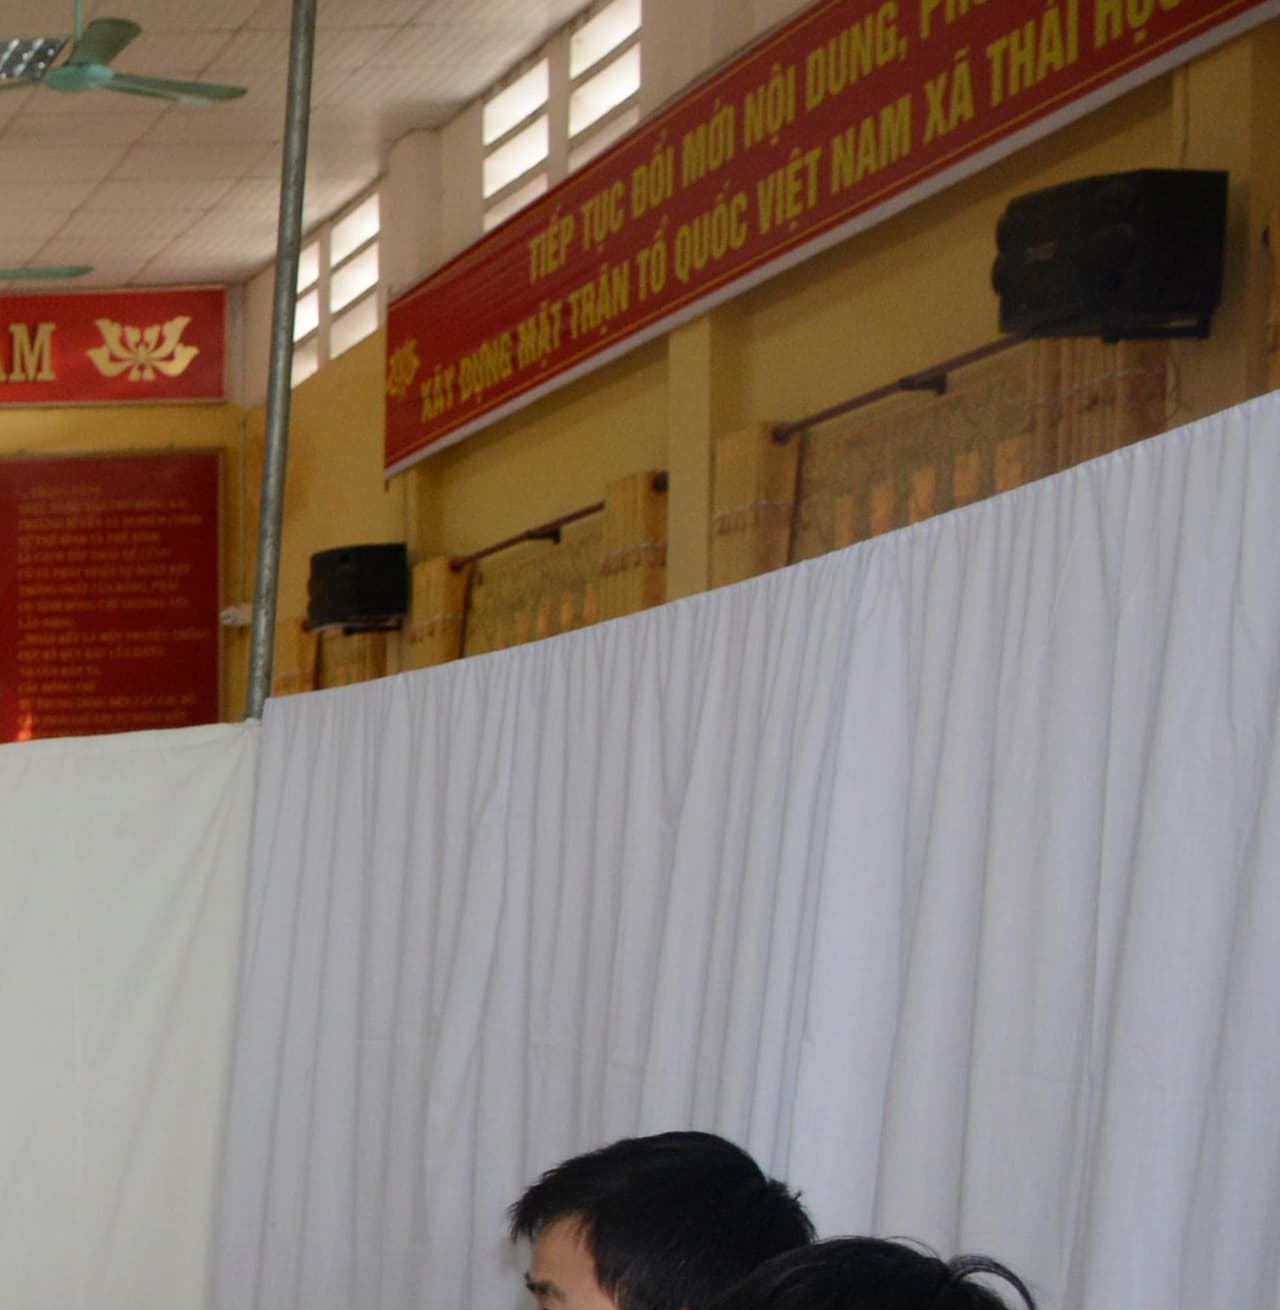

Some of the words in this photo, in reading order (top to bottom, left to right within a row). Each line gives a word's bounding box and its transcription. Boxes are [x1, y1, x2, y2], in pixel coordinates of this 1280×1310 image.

[421, 362, 455, 424] XÂY
[517, 300, 563, 369] MẶT
[568, 260, 630, 340] TRẬN
[637, 215, 668, 301] TỔ
[674, 178, 748, 283] QUỐC
[756, 146, 823, 235] VIỆT
[831, 93, 913, 196] NAM
[923, 45, 975, 144] XÃ
[528, 203, 575, 285] TIẾP
[582, 181, 624, 254] TỤC
[632, 127, 674, 220] ĐỔI
[682, 97, 735, 189] MỚI
[744, 63, 796, 149] NỘI
[805, 2, 908, 113] DUNG,
